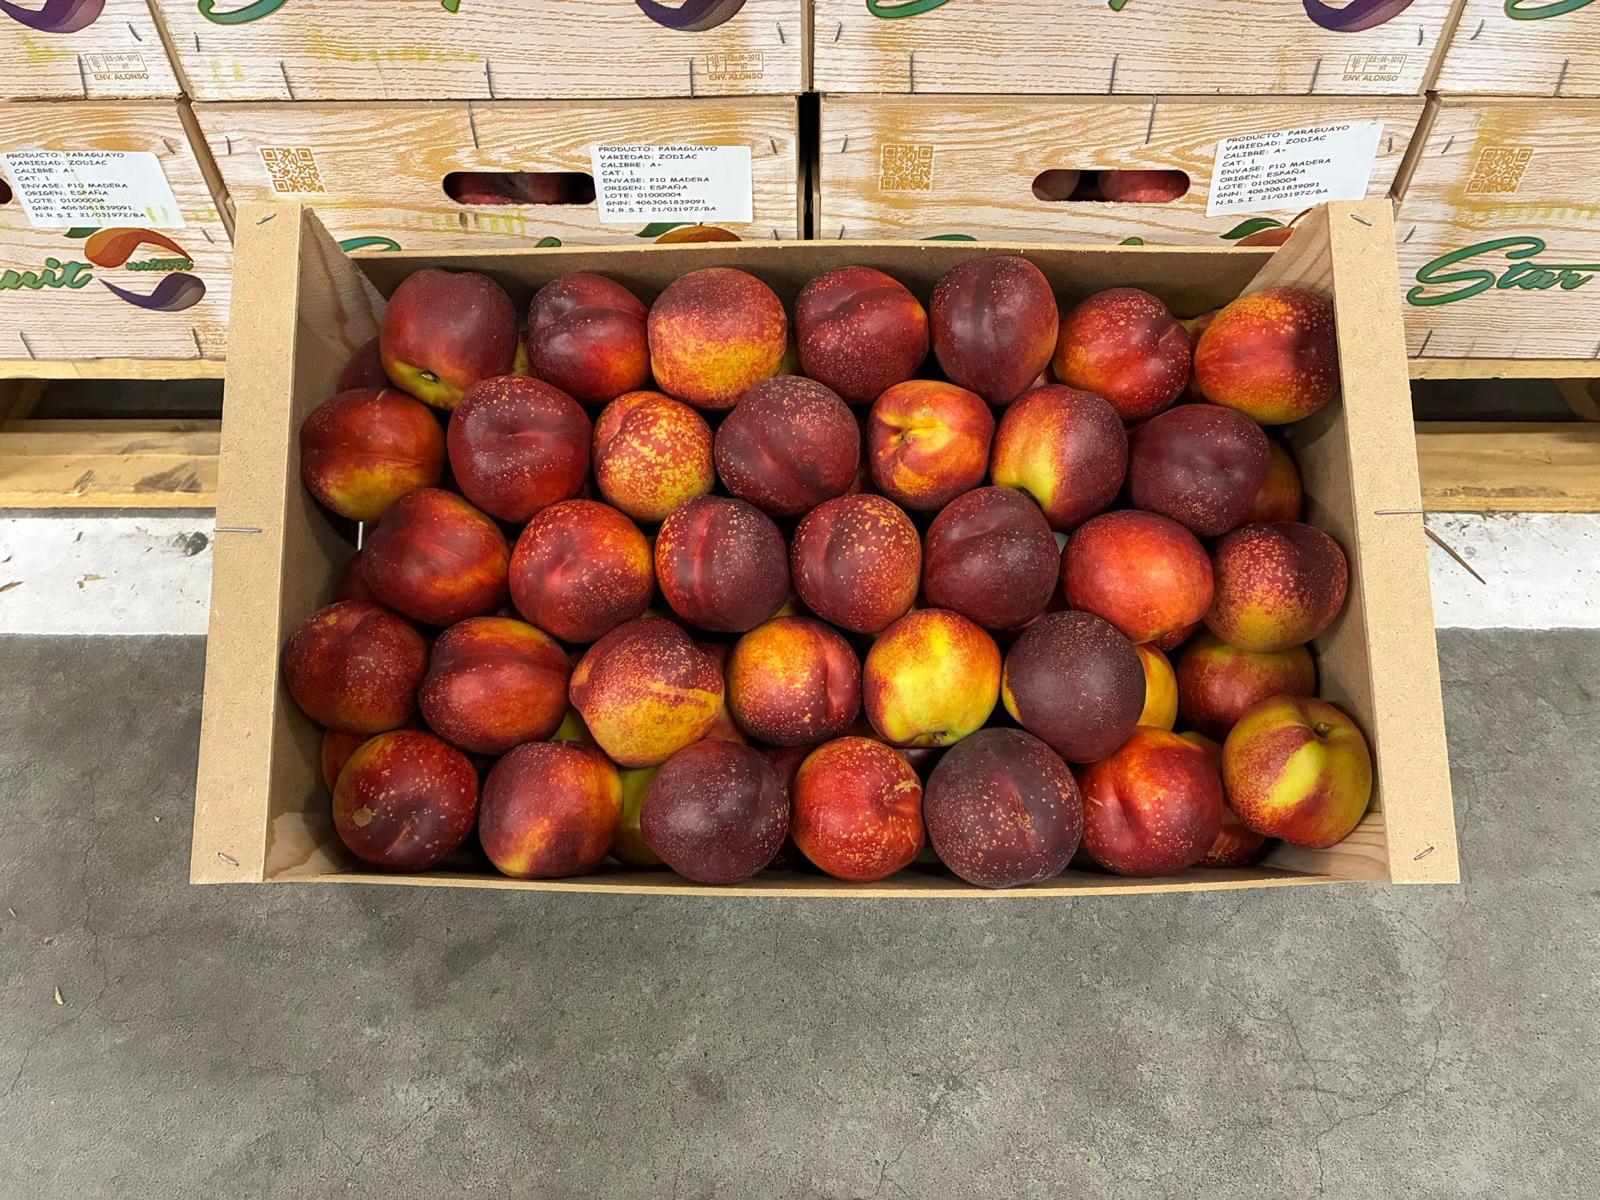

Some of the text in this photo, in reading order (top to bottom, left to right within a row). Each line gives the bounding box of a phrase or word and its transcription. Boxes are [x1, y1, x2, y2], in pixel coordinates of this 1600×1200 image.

[94, 73, 113, 81] ENV.
[709, 72, 763, 81] ENV. ALONSO
[1227, 124, 1350, 144] PRODUCTO: PARAGUAYO
[1225, 135, 1327, 152] VARIEDAD: ZODIAC
[1223, 149, 1269, 160] CALIBRE:
[1221, 165, 1265, 176] ENVASE:
[1290, 158, 1331, 168] MADERA
[1222, 160, 1245, 168] CAT:
[1220, 168, 1306, 183] ORIGEN: ESPAÑA
[1218, 176, 1297, 191] LOTE: 01000004
[1247, 182, 1320, 195] 4063061839091
[70, 188, 108, 196] ESPAÑA
[1261, 188, 1328, 201] 21/031972/BA
